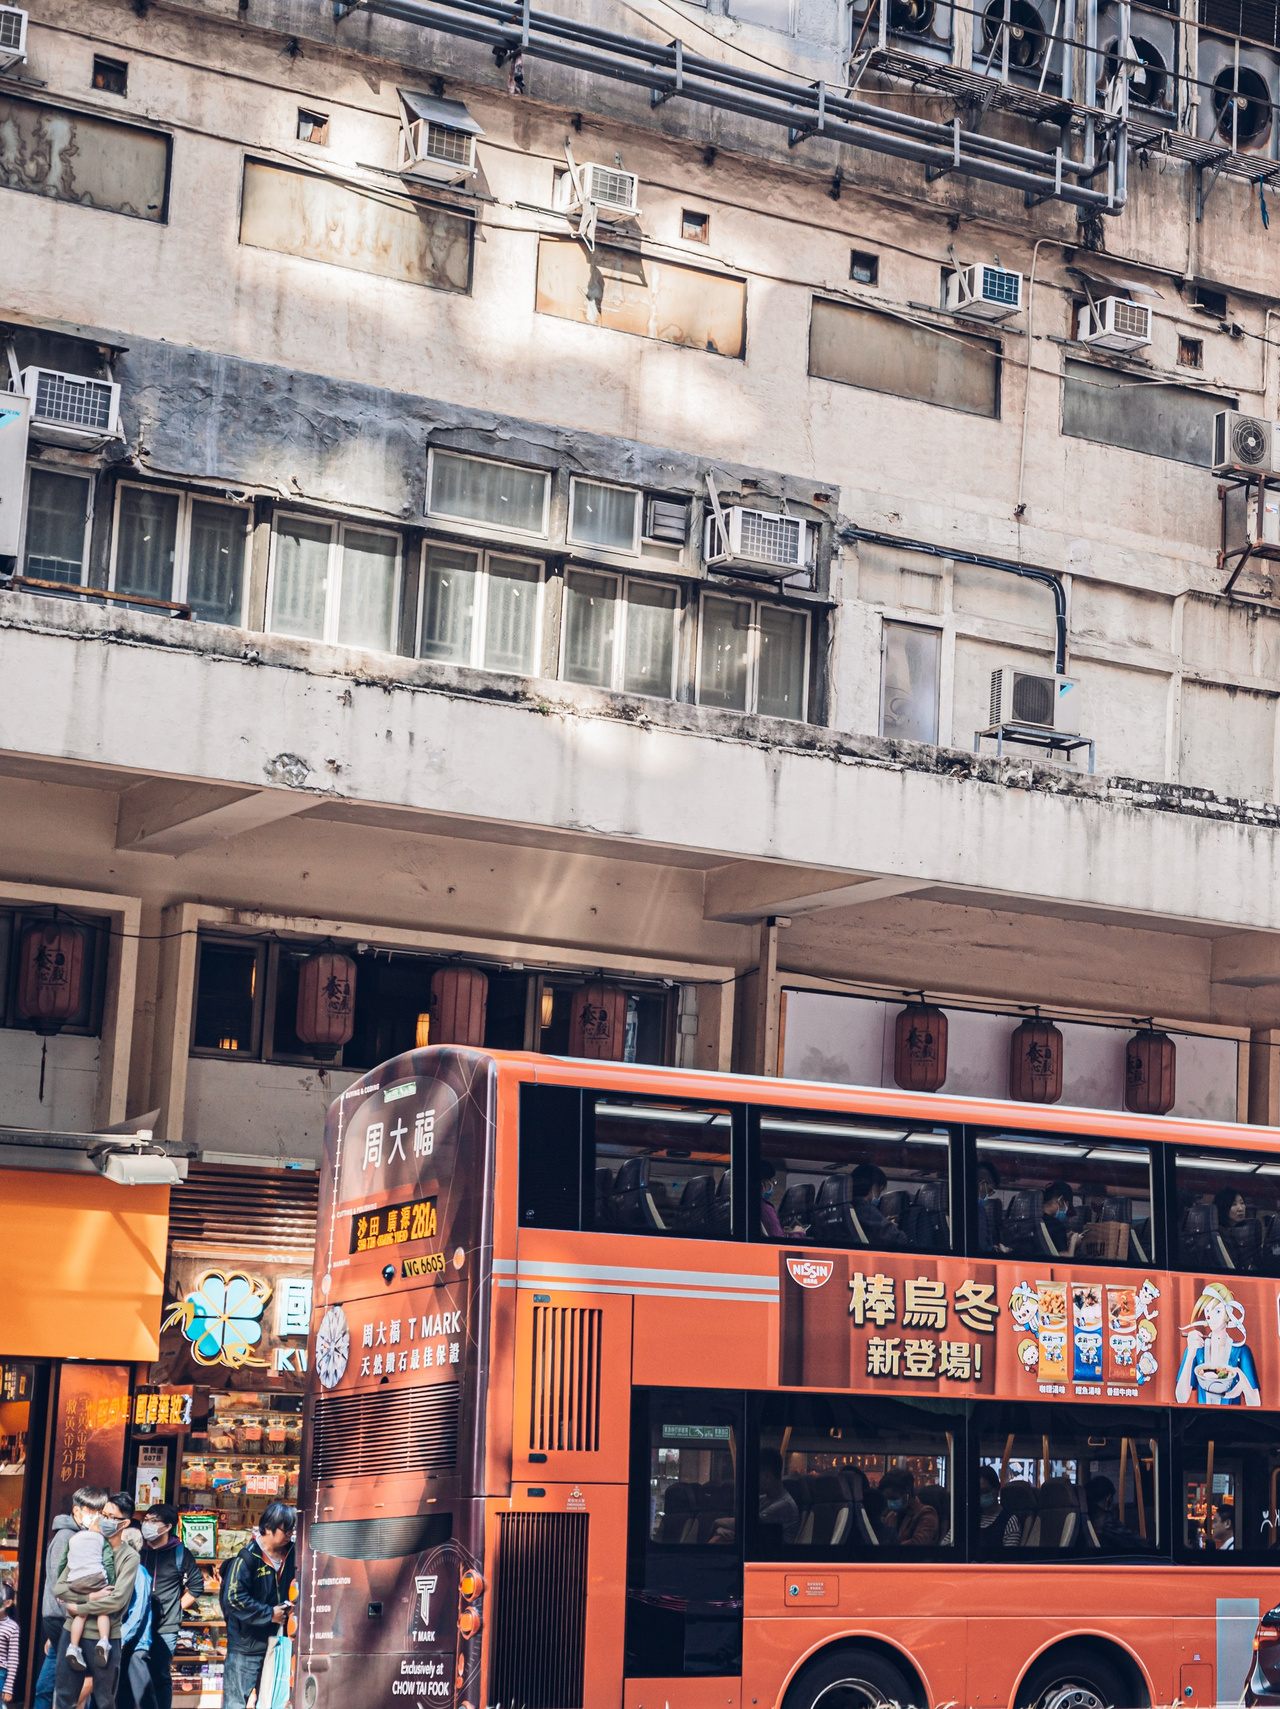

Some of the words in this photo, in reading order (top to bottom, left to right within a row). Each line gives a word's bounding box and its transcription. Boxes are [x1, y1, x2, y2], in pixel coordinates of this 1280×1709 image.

[362, 1109, 436, 1171] 周大福
[357, 1216, 380, 1239] 沙田
[411, 1202, 437, 1240] 281A
[407, 1261, 419, 1276] VG
[421, 1256, 444, 1275] 6605
[792, 1262, 828, 1278] NISSIN
[849, 1272, 1000, 1332] 棒烏冬
[362, 1319, 402, 1348] 周大福
[408, 1318, 417, 1340] T
[421, 1310, 461, 1338] MARK
[361, 1343, 460, 1377] 天然鑽石最佳保證
[867, 1336, 982, 1380] 新登場!
[412, 1631, 417, 1642] T
[418, 1630, 436, 1642] MARK
[400, 1660, 434, 1678] Exclusively
[435, 1662, 444, 1675] at
[392, 1680, 415, 1695] CHOW
[416, 1681, 426, 1696] TAI
[427, 1681, 449, 1696] FOOK
